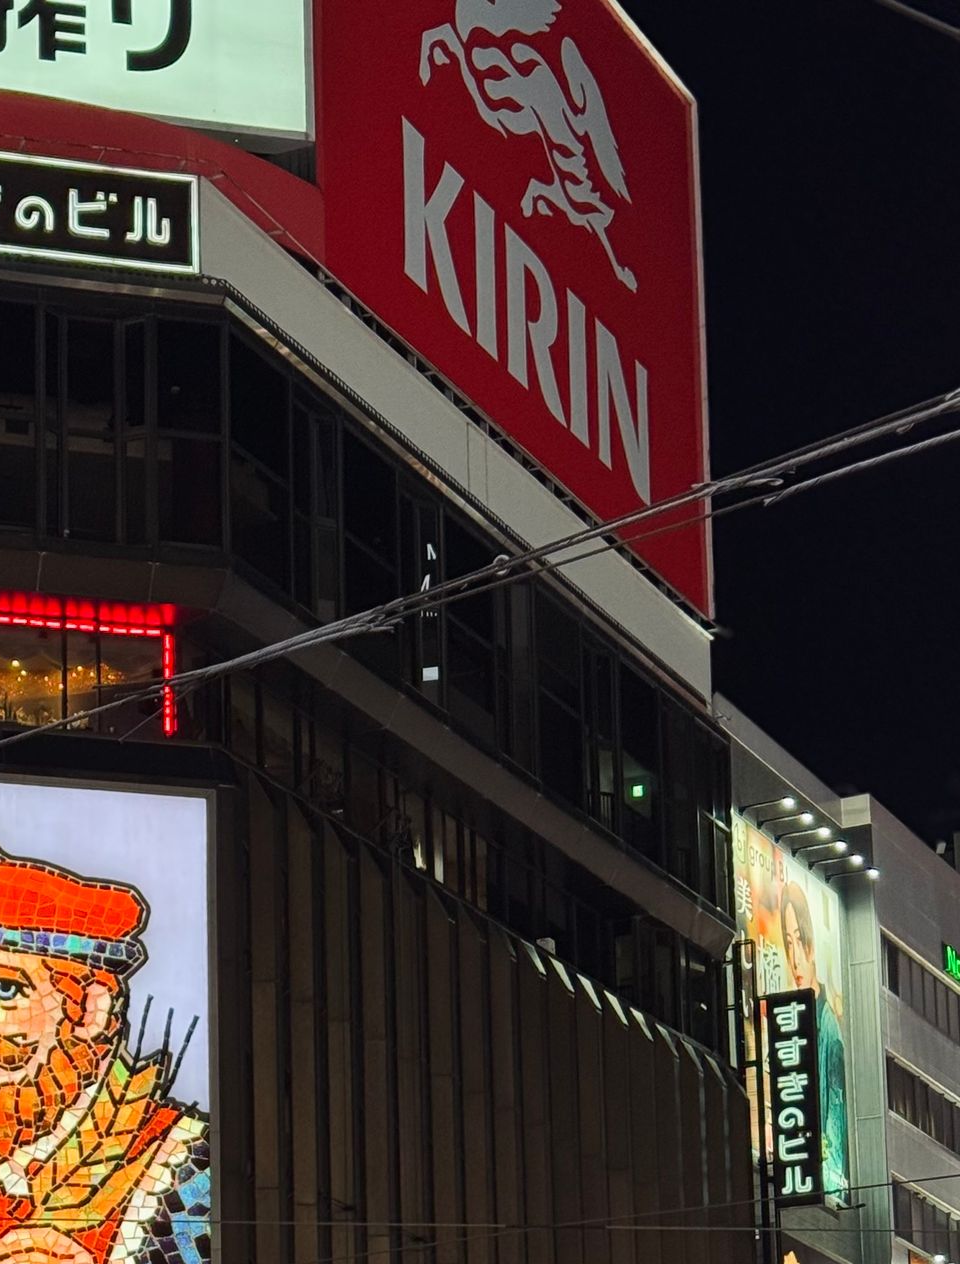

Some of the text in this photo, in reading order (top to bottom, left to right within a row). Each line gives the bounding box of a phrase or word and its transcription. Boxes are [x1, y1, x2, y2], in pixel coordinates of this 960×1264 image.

[401, 115, 650, 505] KIRIN
[772, 1001, 813, 1196] すすきのビル
